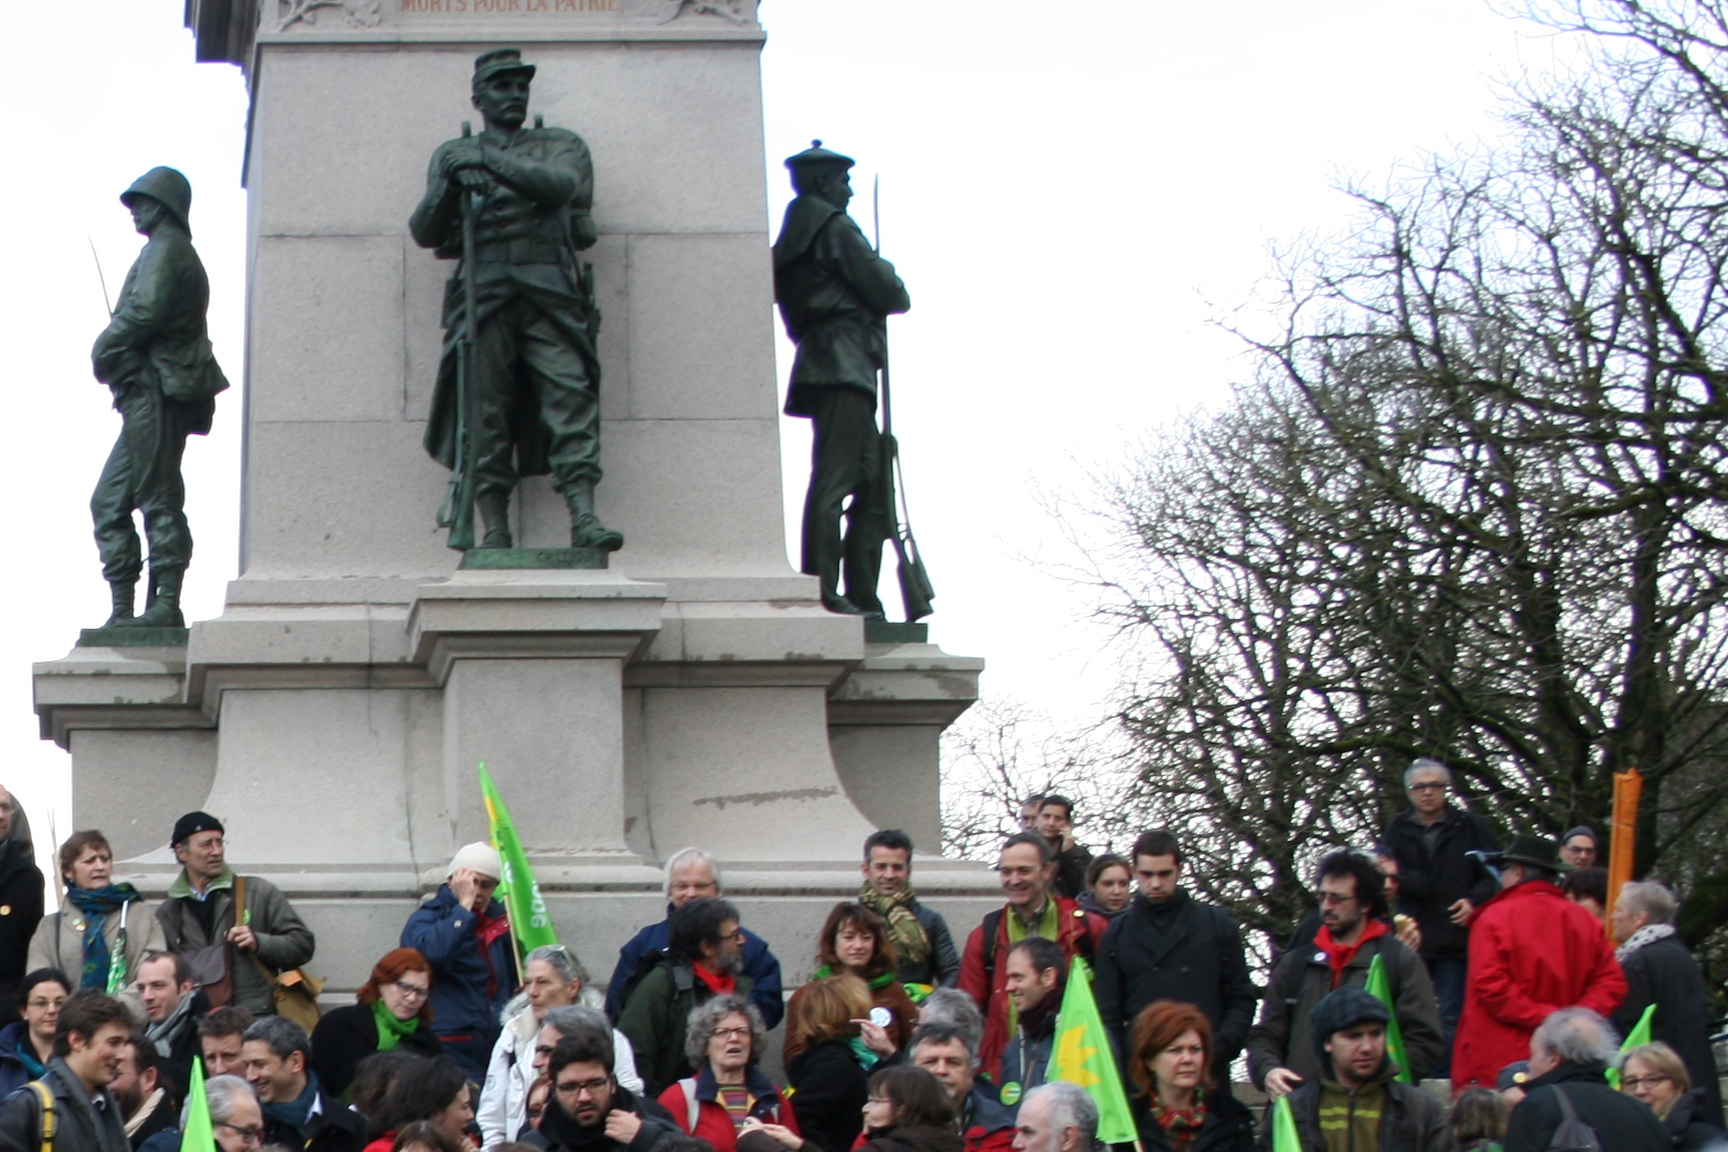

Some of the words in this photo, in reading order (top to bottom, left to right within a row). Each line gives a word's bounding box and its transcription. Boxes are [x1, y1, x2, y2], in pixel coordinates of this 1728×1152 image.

[399, 0, 467, 13] MORTS
[473, 0, 520, 12] POUR
[526, 0, 550, 12] LA
[554, 0, 618, 12] PATRIE
